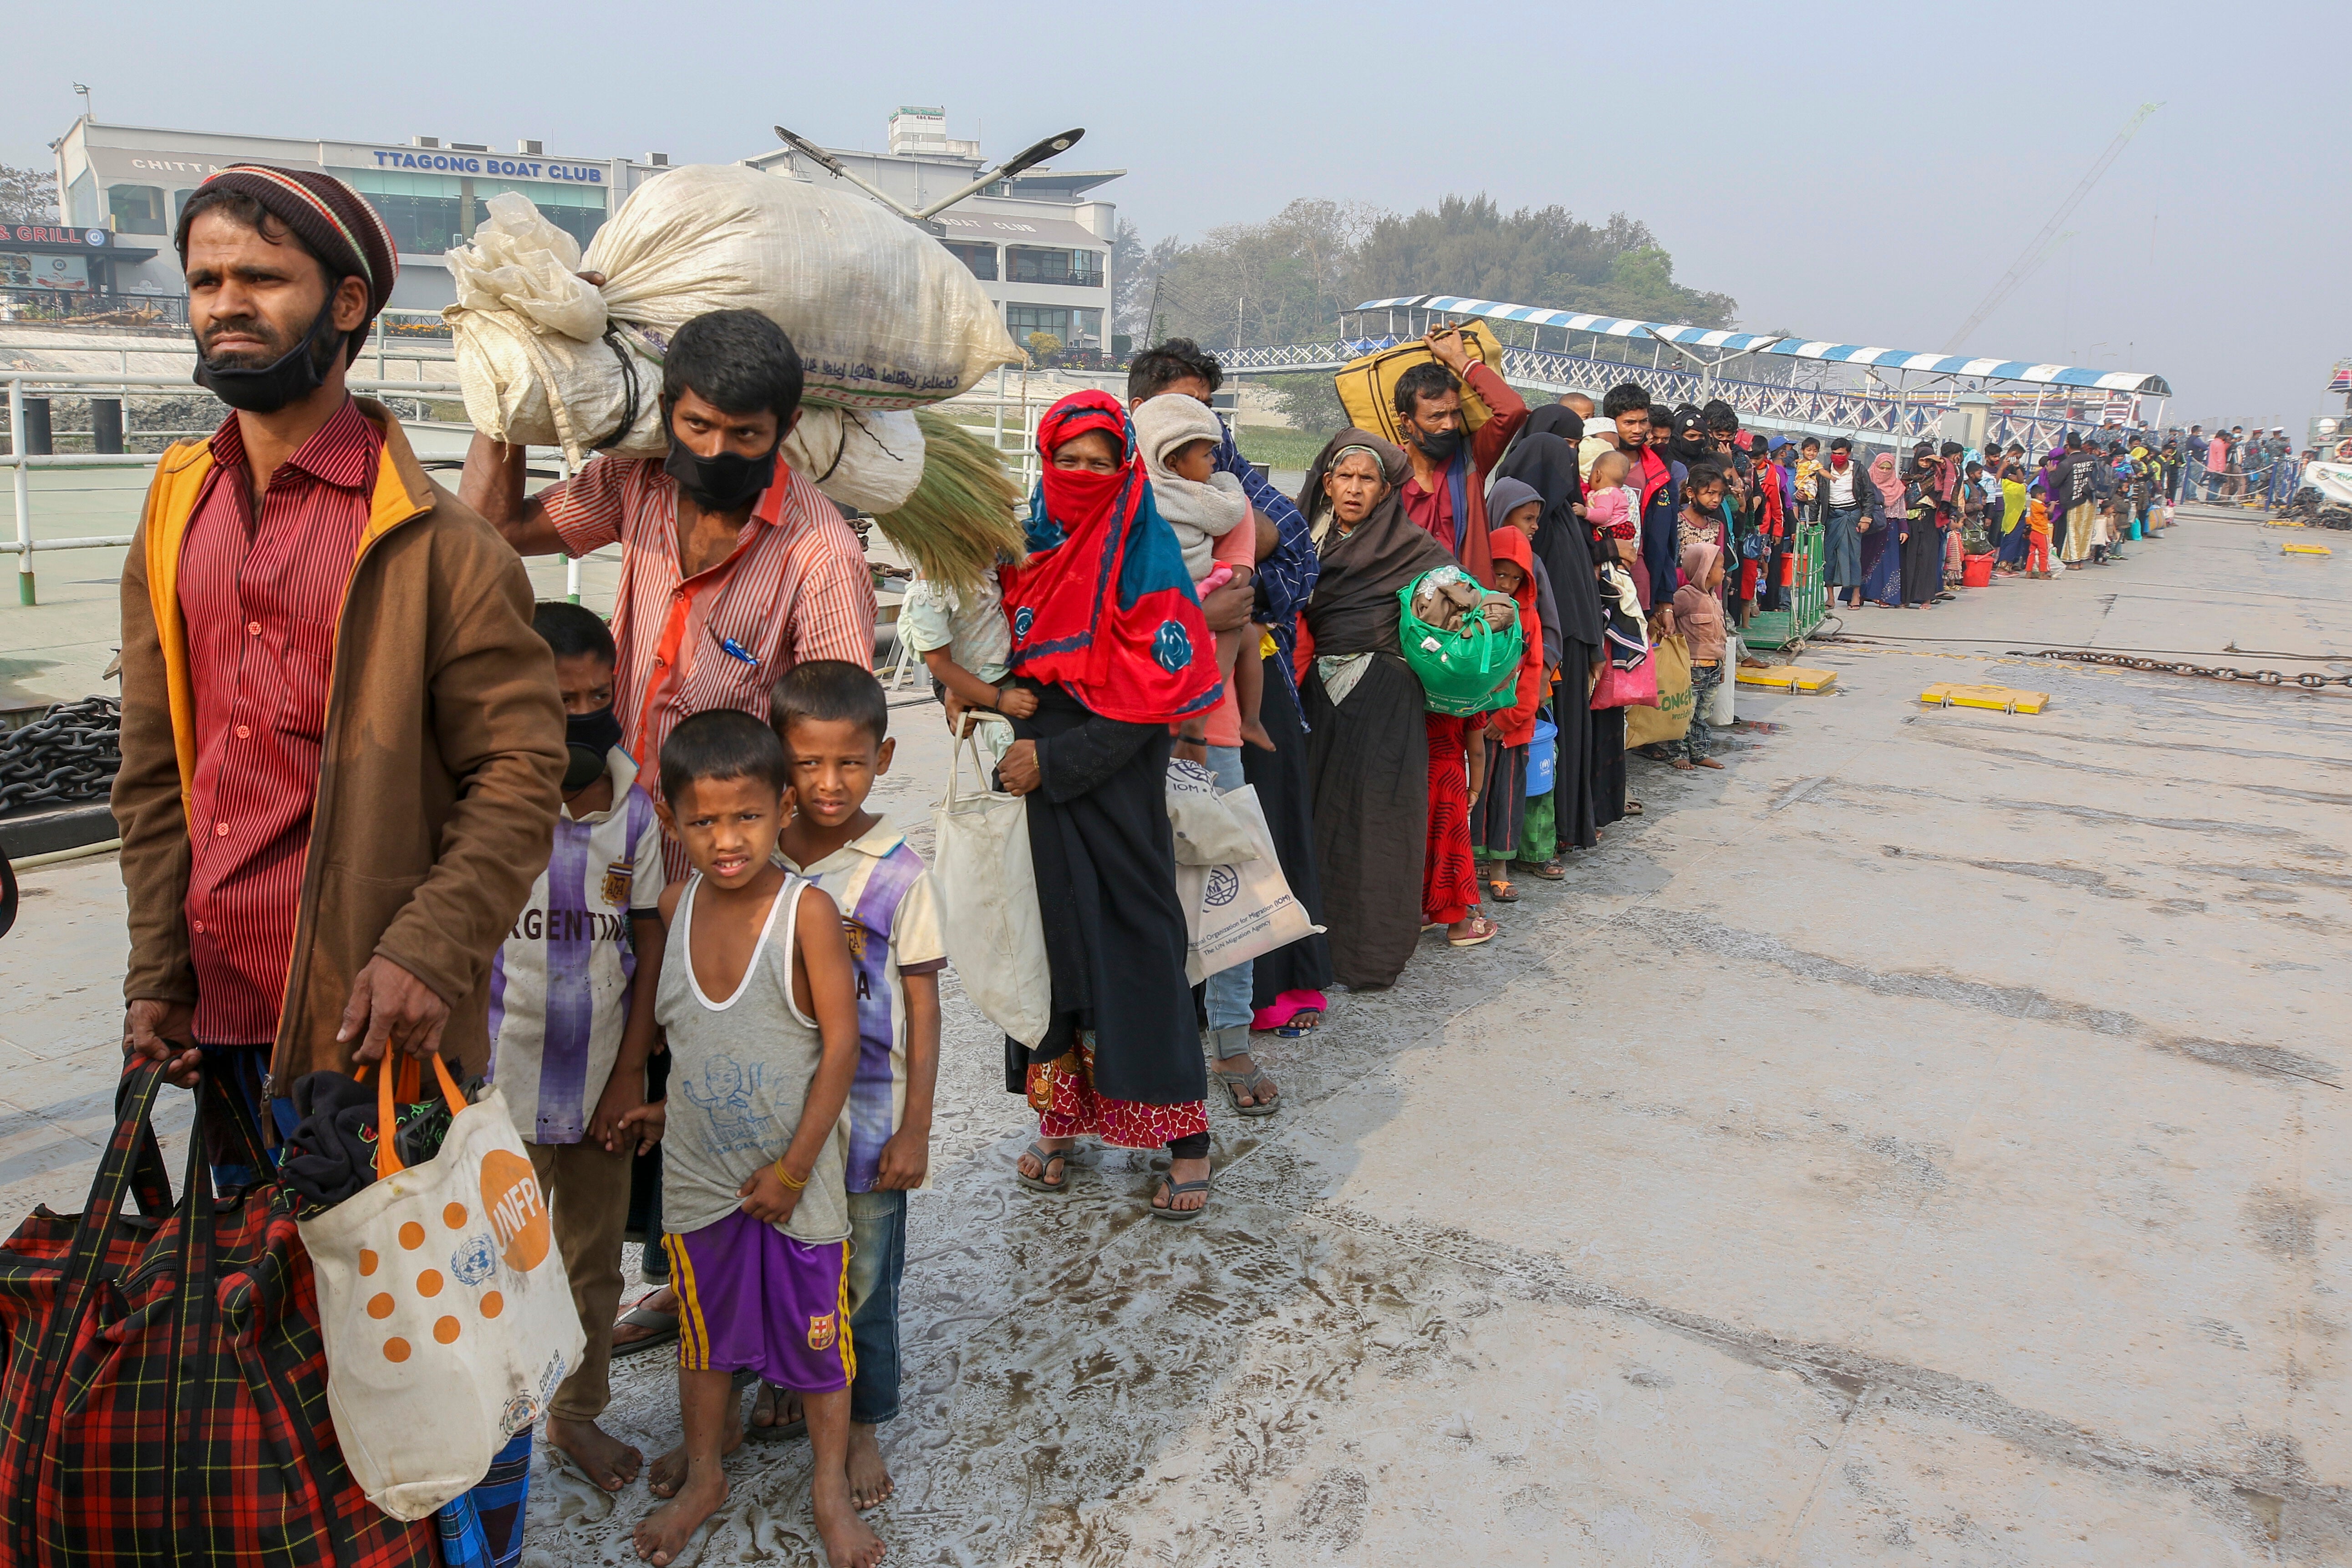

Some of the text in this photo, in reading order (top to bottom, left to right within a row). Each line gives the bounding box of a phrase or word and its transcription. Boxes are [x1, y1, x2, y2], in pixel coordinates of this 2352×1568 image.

[374, 151, 601, 182] TTAGONG BOAT CLUB
[17, 226, 81, 243] GRILL
[937, 217, 1037, 232] BOAT CLUB
[1173, 784, 1199, 793] IOM
[1207, 921, 1239, 941] Organization
[1248, 903, 1273, 920] Migration
[1274, 894, 1291, 907] (IOM)
[1203, 947, 1215, 956] The
[1226, 929, 1251, 946] Migration
[1252, 920, 1271, 932] Agency
[539, 1349, 560, 1393] COVID-19
[543, 1358, 566, 1405] RESPONSE
